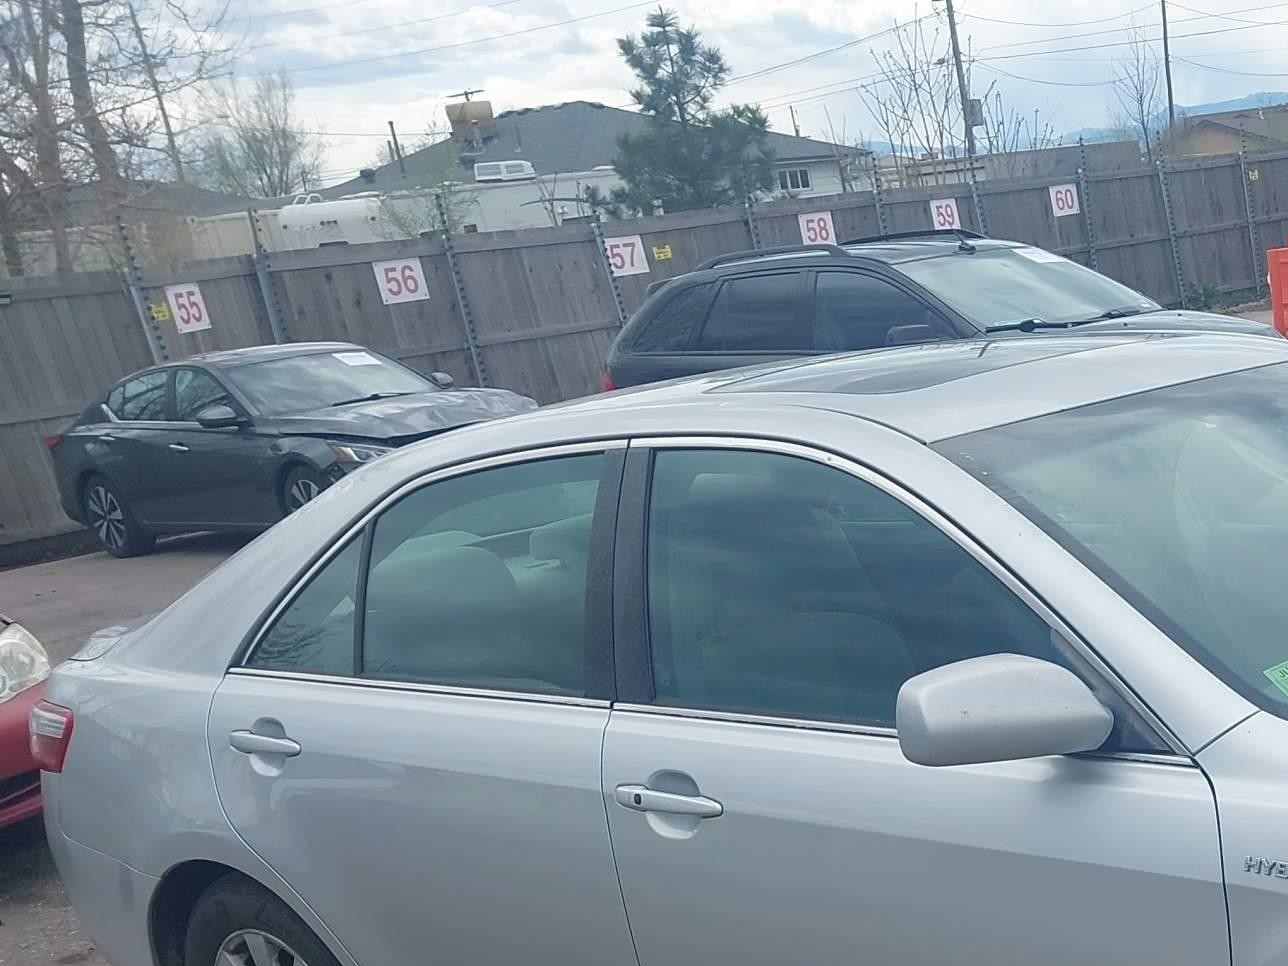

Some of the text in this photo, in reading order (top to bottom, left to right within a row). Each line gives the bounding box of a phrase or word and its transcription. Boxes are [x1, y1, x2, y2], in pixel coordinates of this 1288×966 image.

[1055, 188, 1075, 211] 60
[935, 203, 955, 227] 59
[806, 217, 830, 243] 58
[609, 242, 636, 270] 57
[383, 264, 419, 297] 56
[173, 290, 203, 325] 55
